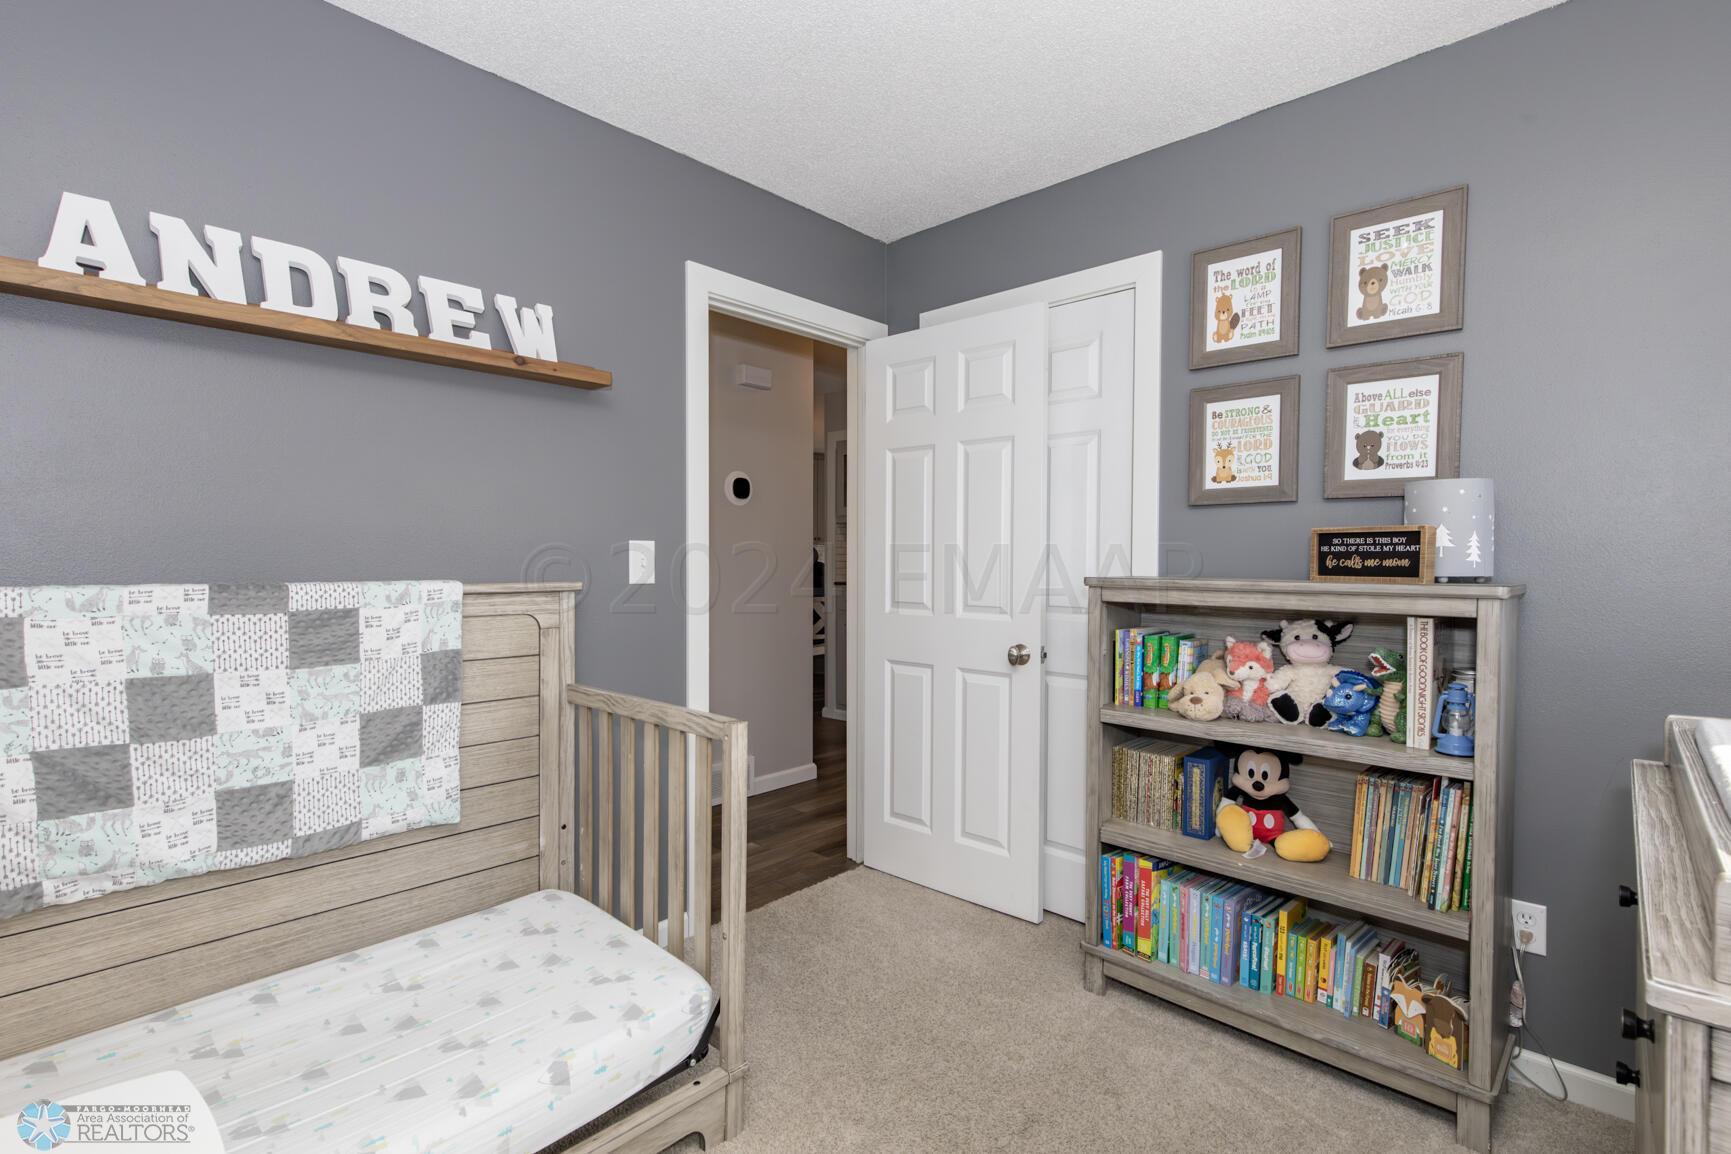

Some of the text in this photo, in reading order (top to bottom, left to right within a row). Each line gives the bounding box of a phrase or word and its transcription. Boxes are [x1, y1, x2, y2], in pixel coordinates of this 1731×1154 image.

[1358, 218, 1435, 244] SEEK
[1359, 230, 1434, 254] JUSTICE
[1358, 242, 1434, 267] LOVE
[1390, 255, 1432, 268] MERCY
[37, 191, 558, 363] ANDREW
[1214, 258, 1276, 282] The word of
[1391, 263, 1432, 278] WALK
[1213, 285, 1229, 293] the
[1245, 290, 1272, 302] LAMP
[1389, 290, 1432, 305] GOD
[1389, 305, 1412, 316] Micah
[1241, 319, 1275, 330] PATH
[1354, 388, 1431, 403] Above ALL else
[1211, 405, 1272, 419] Be STRONG &
[1364, 410, 1430, 428] Heart
[1237, 438, 1272, 453] LORD
[1245, 453, 1272, 464] GOD
[1386, 453, 1414, 461] from
[1385, 461, 1413, 470] Proverbs
[1325, 554, 1410, 569] he calls me mom
[1420, 621, 1429, 632] THE
[1420, 632, 1429, 653] BOOK
[1419, 655, 1428, 664] OF
[1418, 665, 1428, 711] GOODNIGHT
